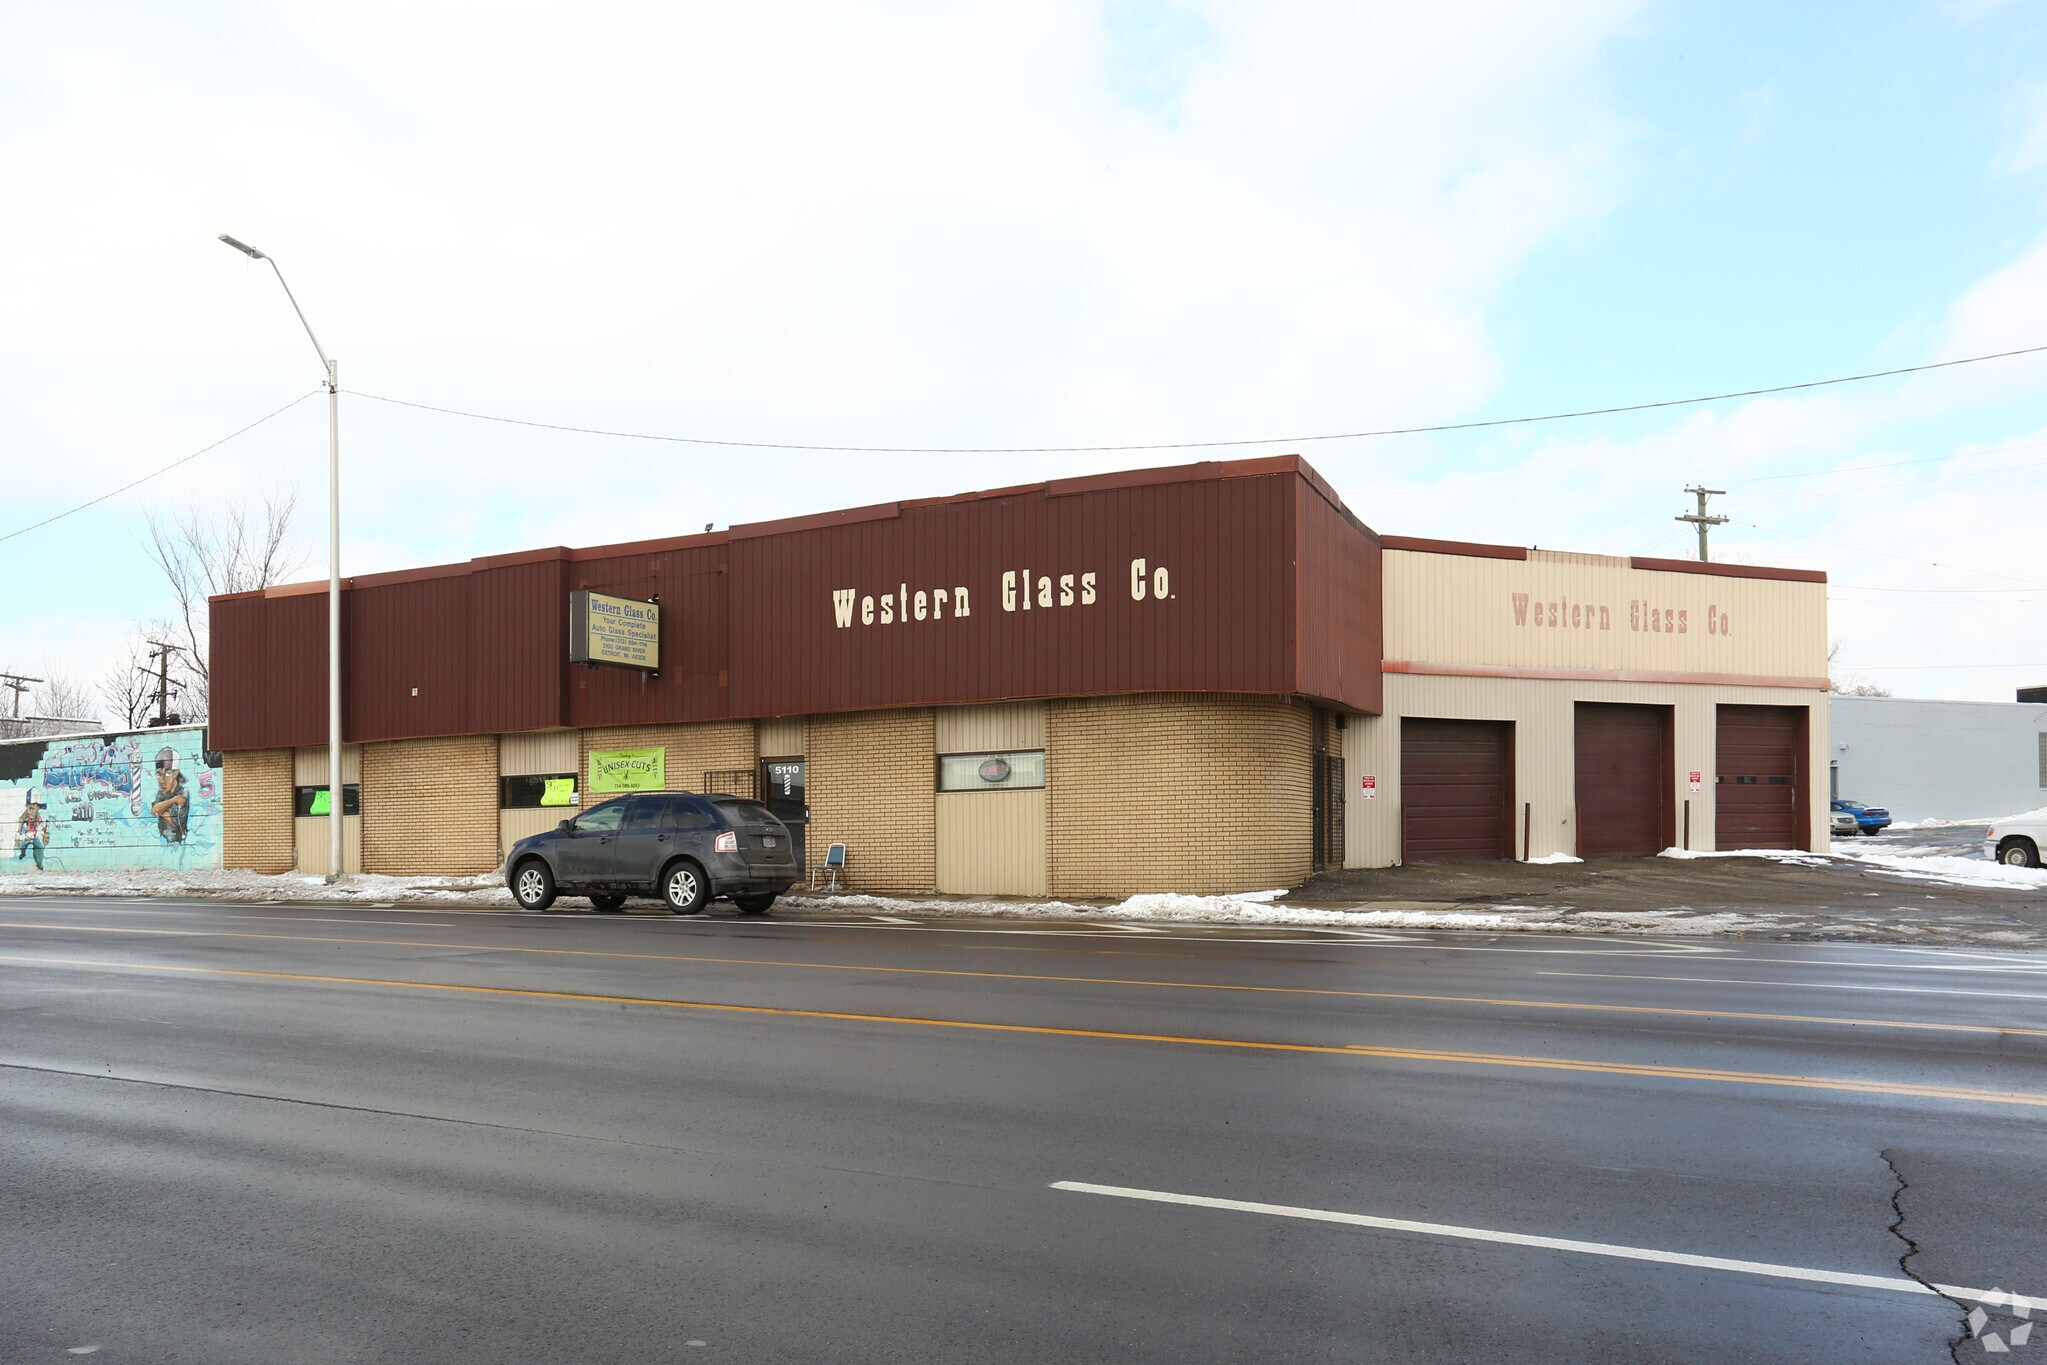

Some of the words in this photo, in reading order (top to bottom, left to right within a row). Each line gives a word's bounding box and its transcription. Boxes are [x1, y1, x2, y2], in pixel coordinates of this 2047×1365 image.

[833, 583, 970, 629] Western
[1002, 569, 1096, 612] Glass
[1130, 558, 1176, 601] Co.
[591, 599, 621, 615] Western
[624, 605, 644, 619] Glass
[646, 608, 658, 621] Co.
[1512, 592, 1610, 631] Western
[1630, 600, 1688, 634] Glass
[603, 616, 615, 624] Your
[618, 619, 646, 629] Complete
[592, 624, 606, 633] Auto
[608, 627, 625, 635] Glass
[627, 630, 656, 640] Specialist
[603, 760, 630, 774] UNISEX
[631, 760, 652, 773] CUTS
[775, 765, 799, 774] 5110
